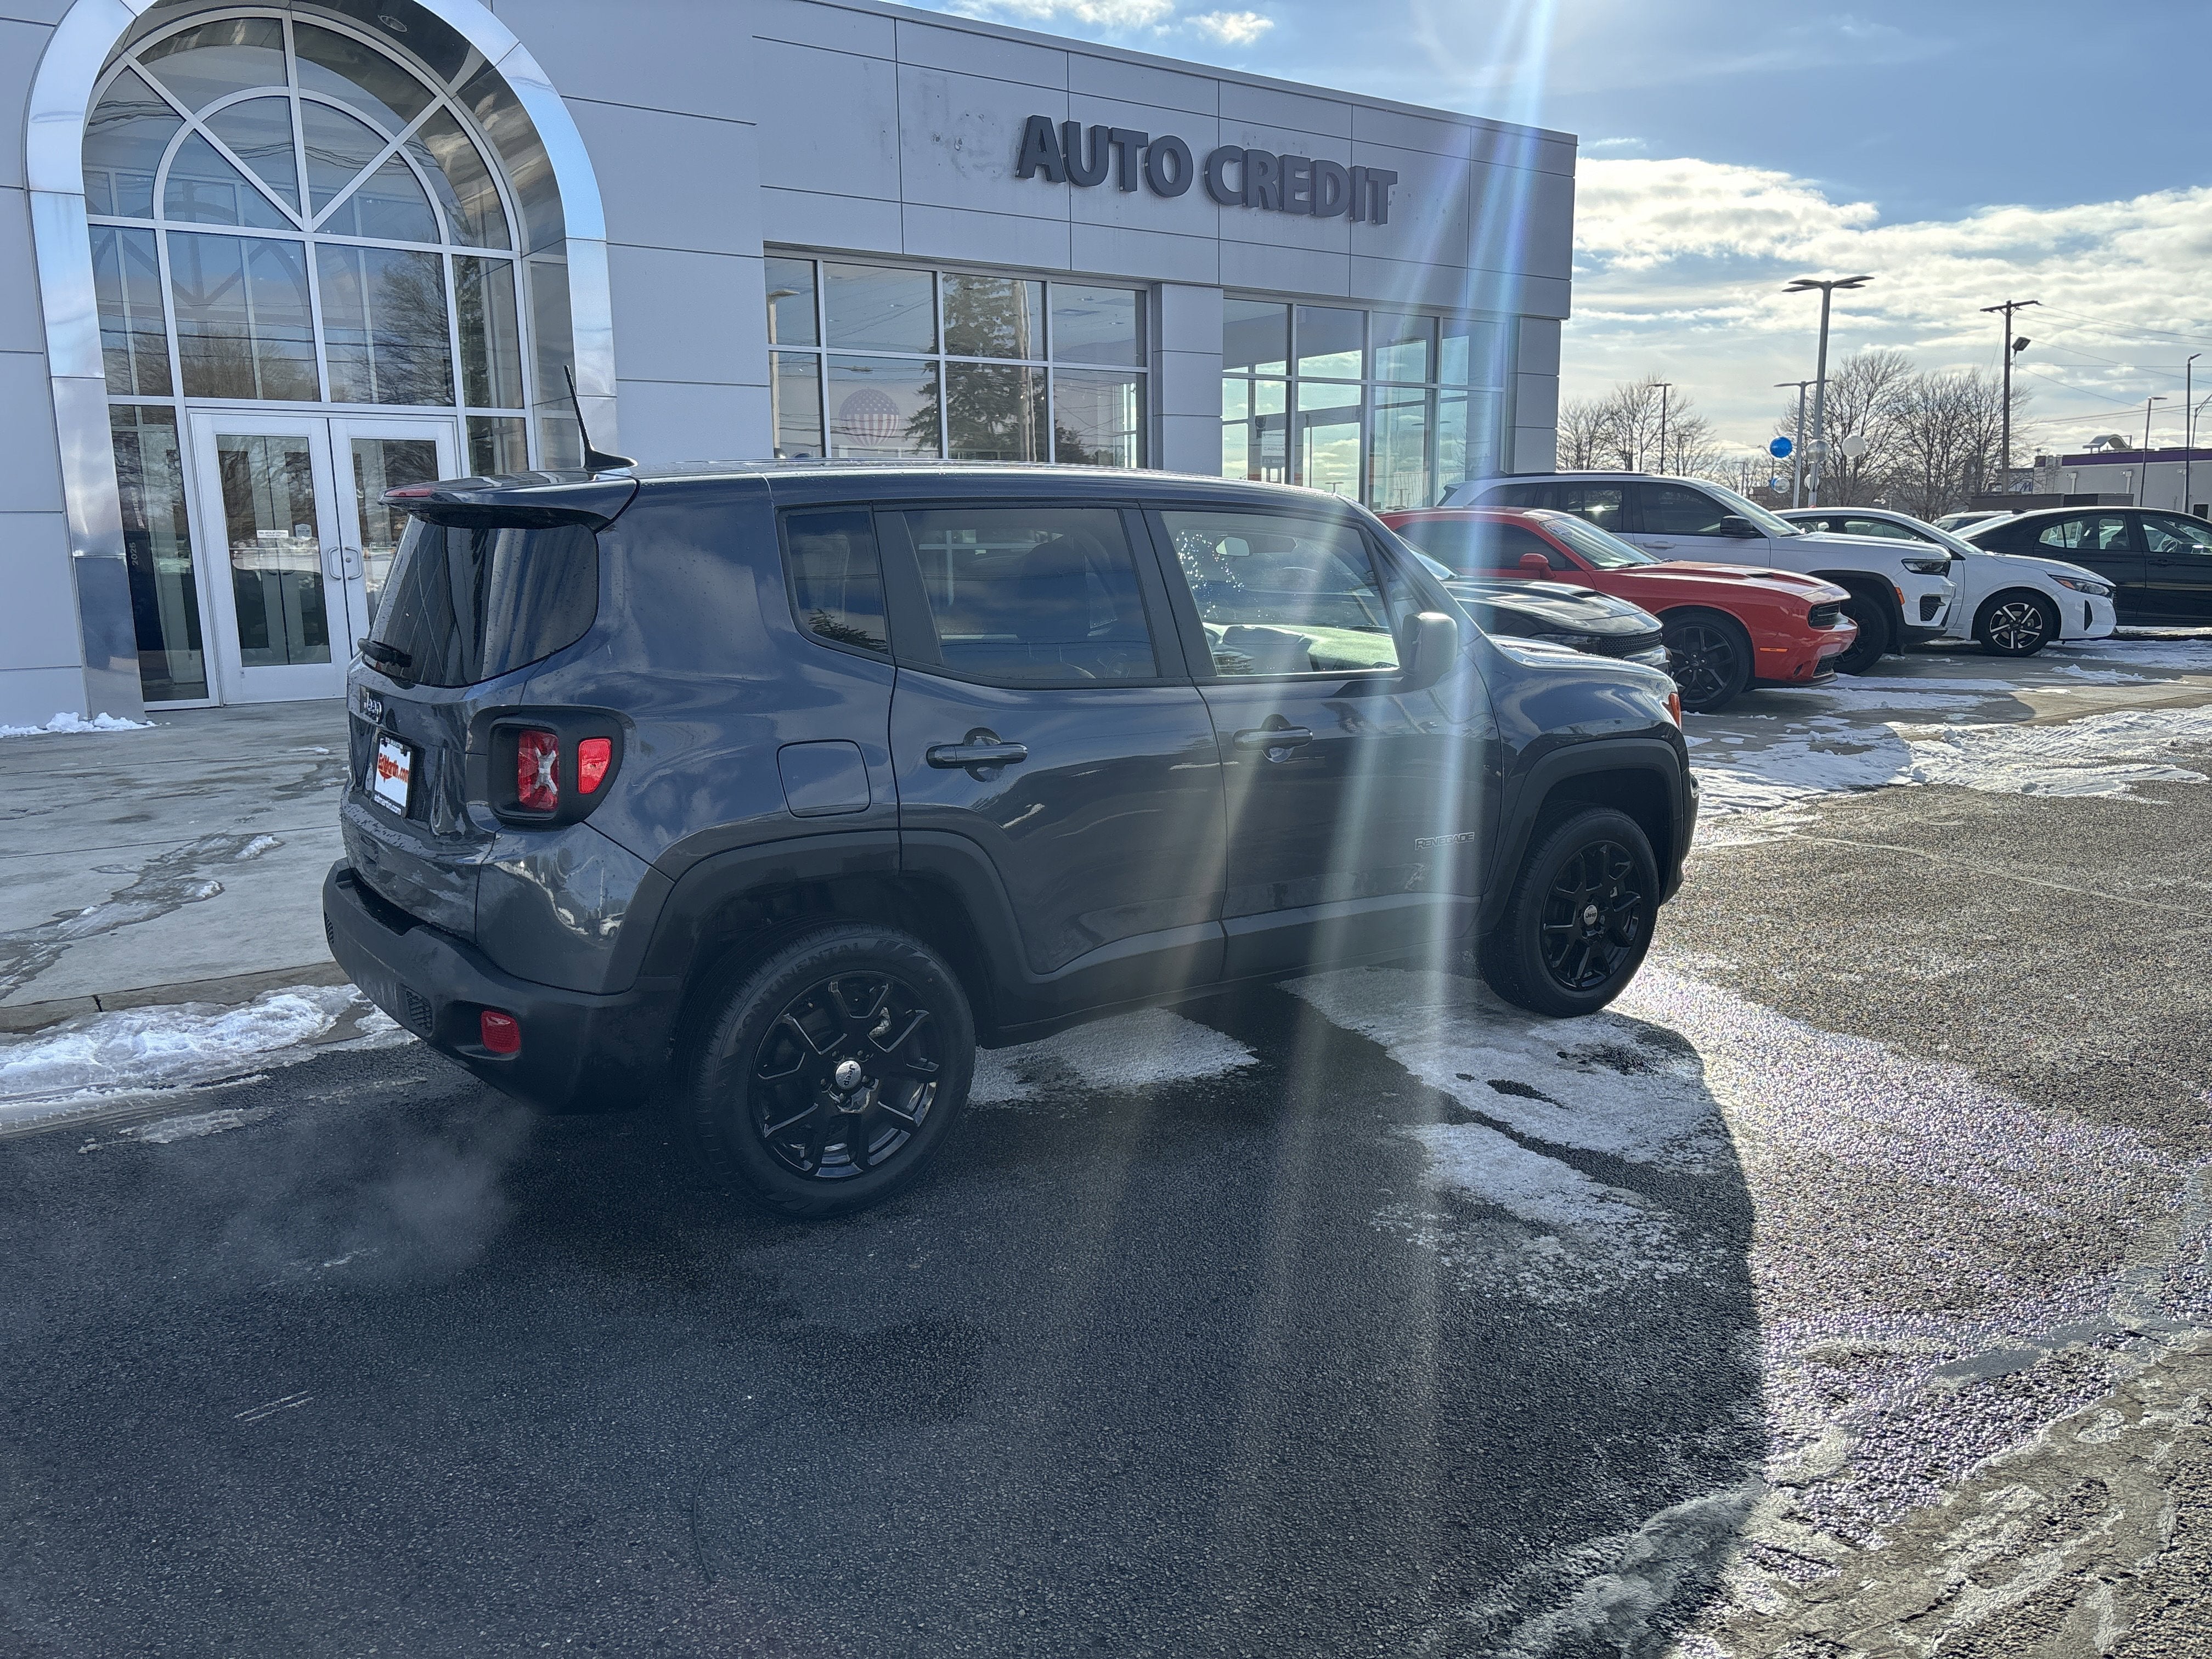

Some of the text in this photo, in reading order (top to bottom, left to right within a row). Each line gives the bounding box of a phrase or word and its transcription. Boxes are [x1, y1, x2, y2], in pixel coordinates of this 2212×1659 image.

[1015, 115, 1398, 224] AUTO CREDIT
[363, 692, 382, 723] Jeep
[1415, 832, 1475, 850] RENEGADE
[843, 1064, 856, 1086] Jeep
